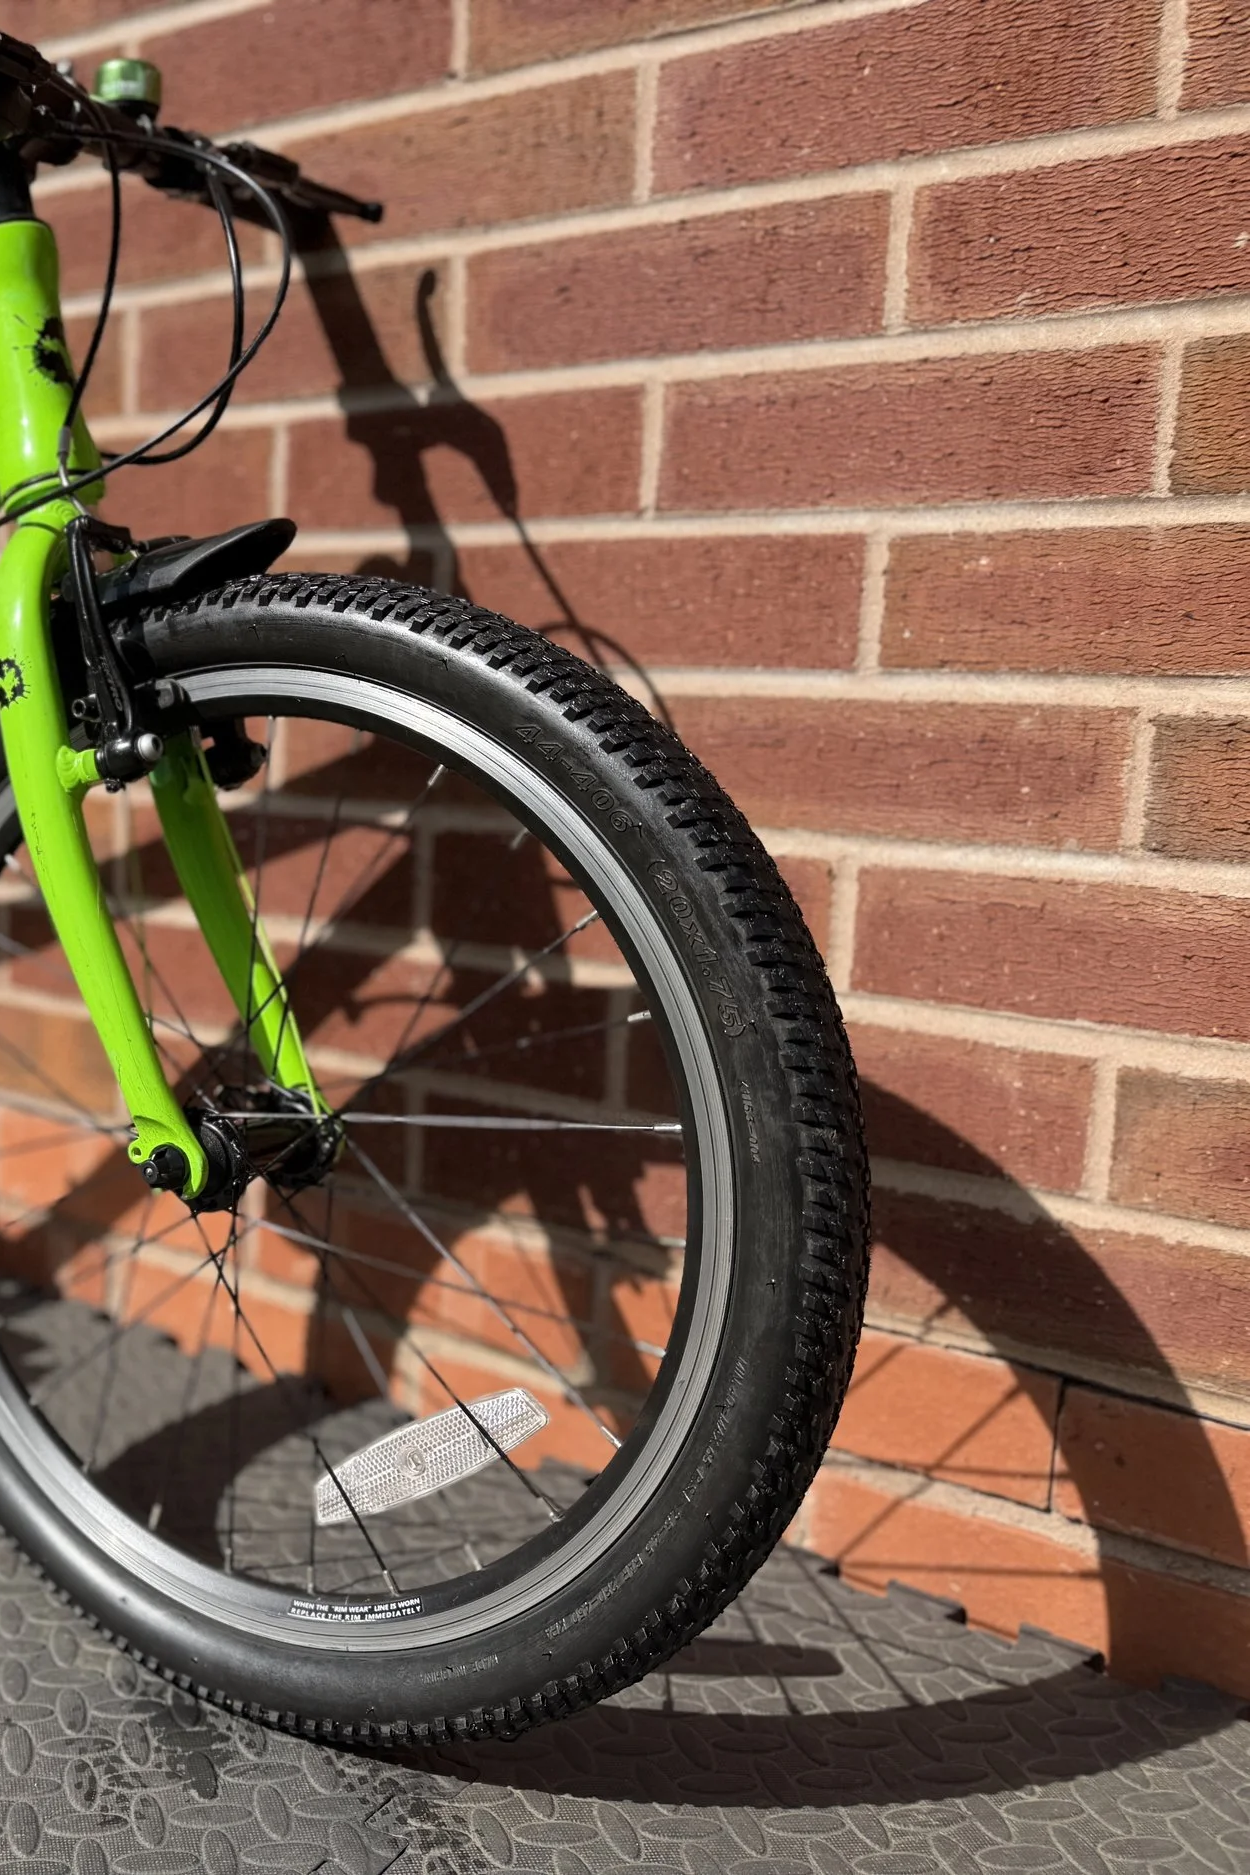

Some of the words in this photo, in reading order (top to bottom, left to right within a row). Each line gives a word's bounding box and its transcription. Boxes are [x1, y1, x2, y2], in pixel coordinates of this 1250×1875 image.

[515, 724, 634, 834] 44-406
[293, 1600, 315, 1610] WHEN
[374, 1603, 389, 1612] LINE
[390, 1602, 397, 1610] IS
[398, 1597, 420, 1608] WORN
[291, 1607, 326, 1620] REPLACE
[328, 1613, 342, 1621] THE
[364, 1605, 421, 1621] IMMEDIATELY
